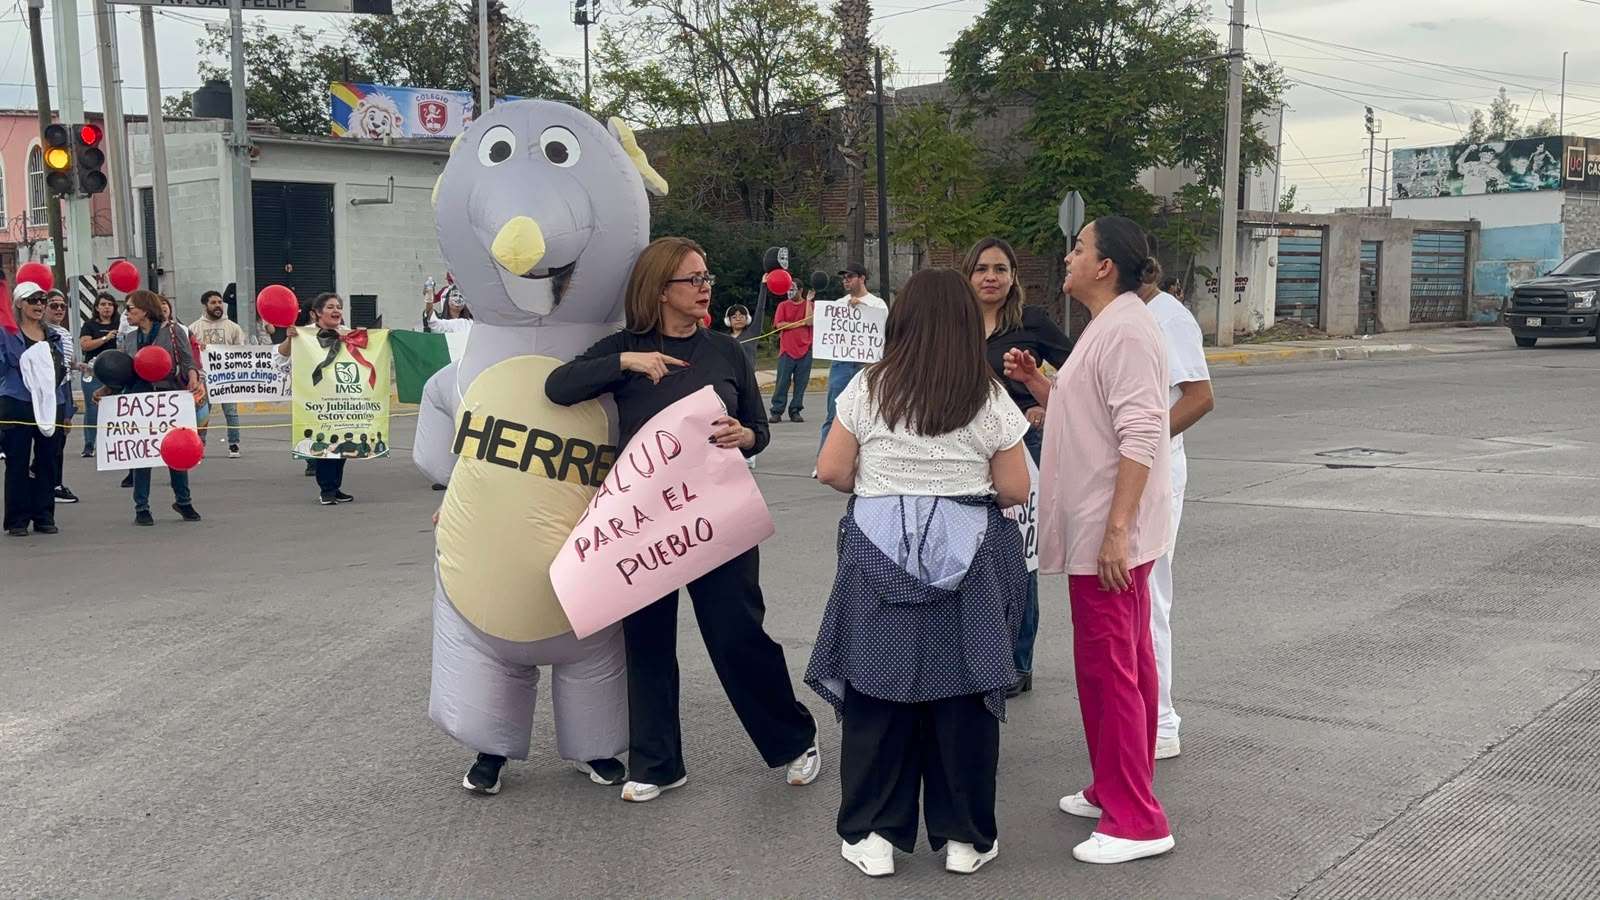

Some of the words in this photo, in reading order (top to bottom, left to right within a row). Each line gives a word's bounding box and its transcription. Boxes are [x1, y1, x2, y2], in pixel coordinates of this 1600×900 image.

[416, 93, 449, 104] COLEGIO
[824, 304, 862, 321] PUEBLO
[831, 318, 878, 333] ESCUCHA
[822, 333, 846, 345] ESTA
[850, 335, 864, 346] ES
[868, 335, 883, 348] TU
[208, 351, 222, 361] No
[224, 351, 252, 360] somos
[255, 351, 272, 359] una
[833, 346, 875, 360] LUCHA
[210, 362, 222, 371] no
[224, 361, 252, 369] somos
[207, 371, 236, 384] somos
[237, 371, 249, 380] un
[250, 369, 278, 384] chingo
[209, 383, 256, 397] cuéntanos
[257, 383, 277, 394] bien
[335, 384, 362, 394] IMSS
[117, 393, 179, 418] BASES
[305, 401, 325, 413] Soy
[106, 421, 139, 437] PARA
[149, 418, 177, 435] LOS
[105, 438, 161, 463] HEROES
[574, 504, 655, 562] PARA
[662, 481, 698, 512] EL
[615, 517, 714, 585] PUEBLO
